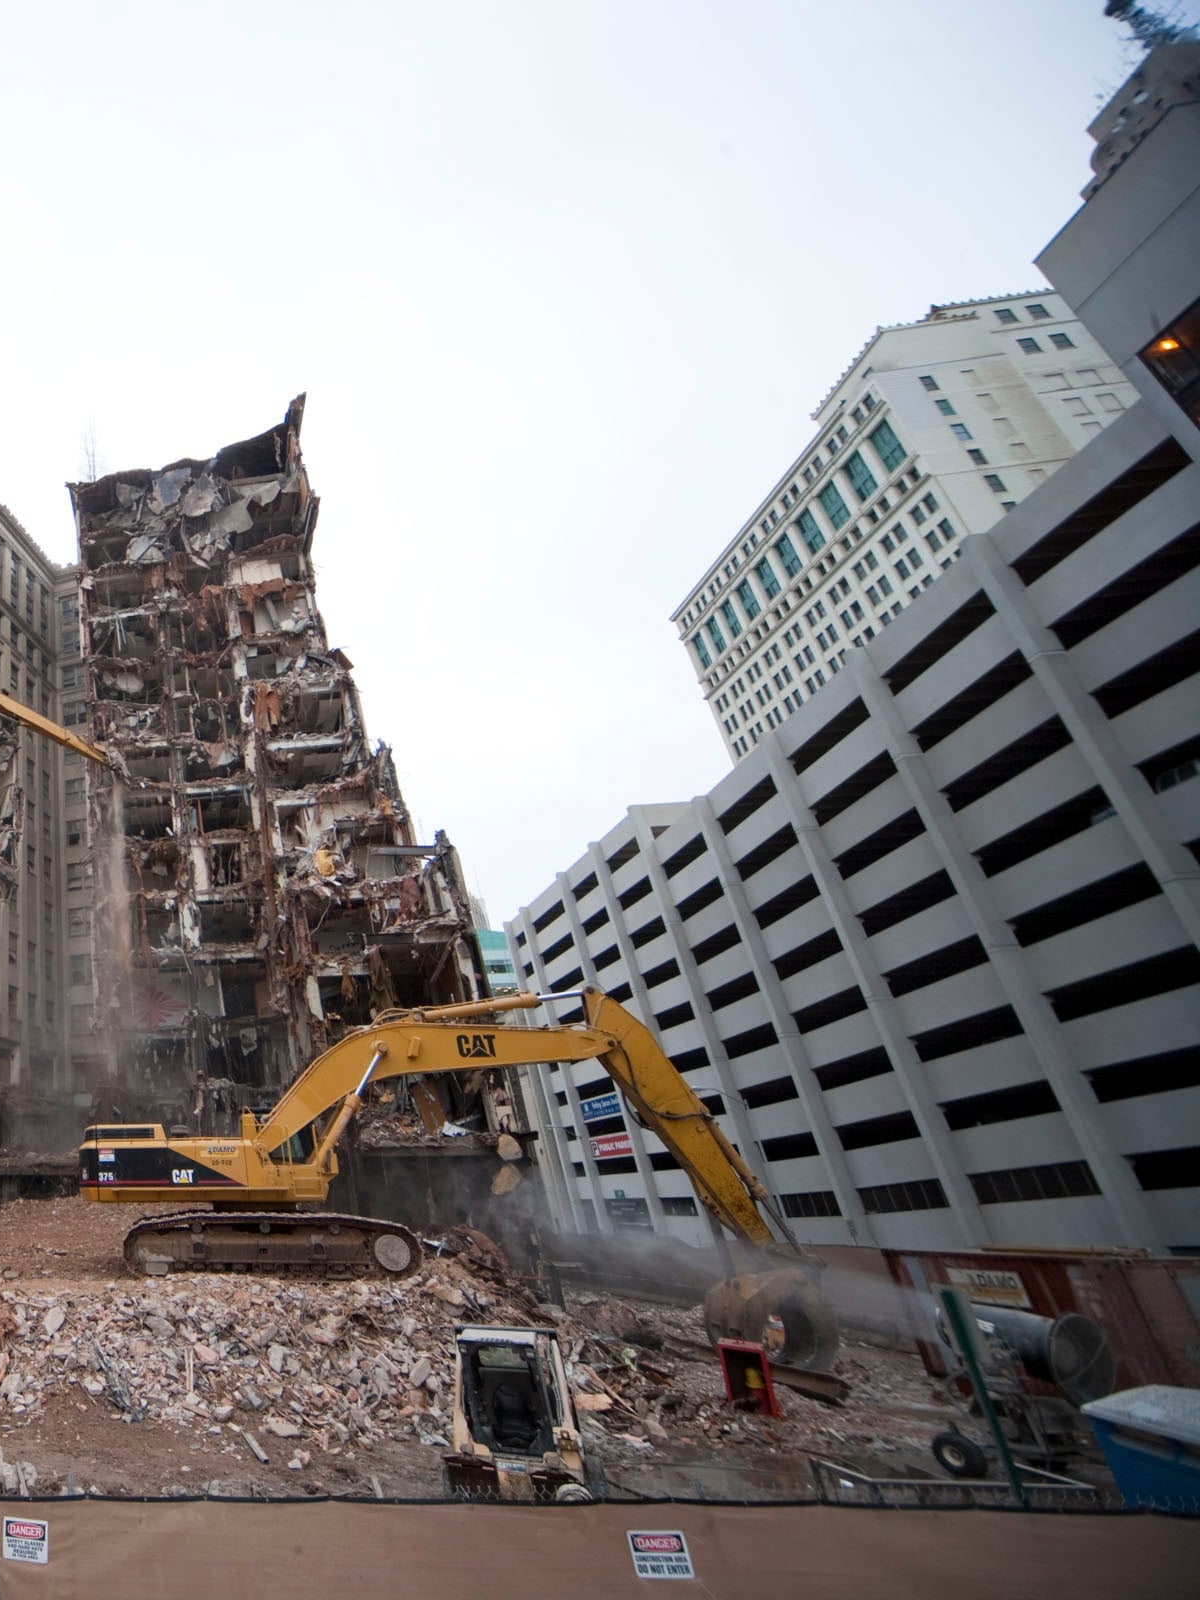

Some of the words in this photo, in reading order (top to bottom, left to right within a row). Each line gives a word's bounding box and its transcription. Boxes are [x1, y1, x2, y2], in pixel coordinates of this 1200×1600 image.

[456, 1034, 497, 1058] CAT
[208, 1146, 236, 1154] ADAMO
[98, 1172, 114, 1181] 375
[172, 1169, 194, 1184] CAT
[10, 1525, 41, 1537] DANGER
[636, 1538, 678, 1550] DANGER
[637, 1564, 649, 1574] DO
[649, 1564, 665, 1574] NOT
[666, 1564, 691, 1575] ENTER
